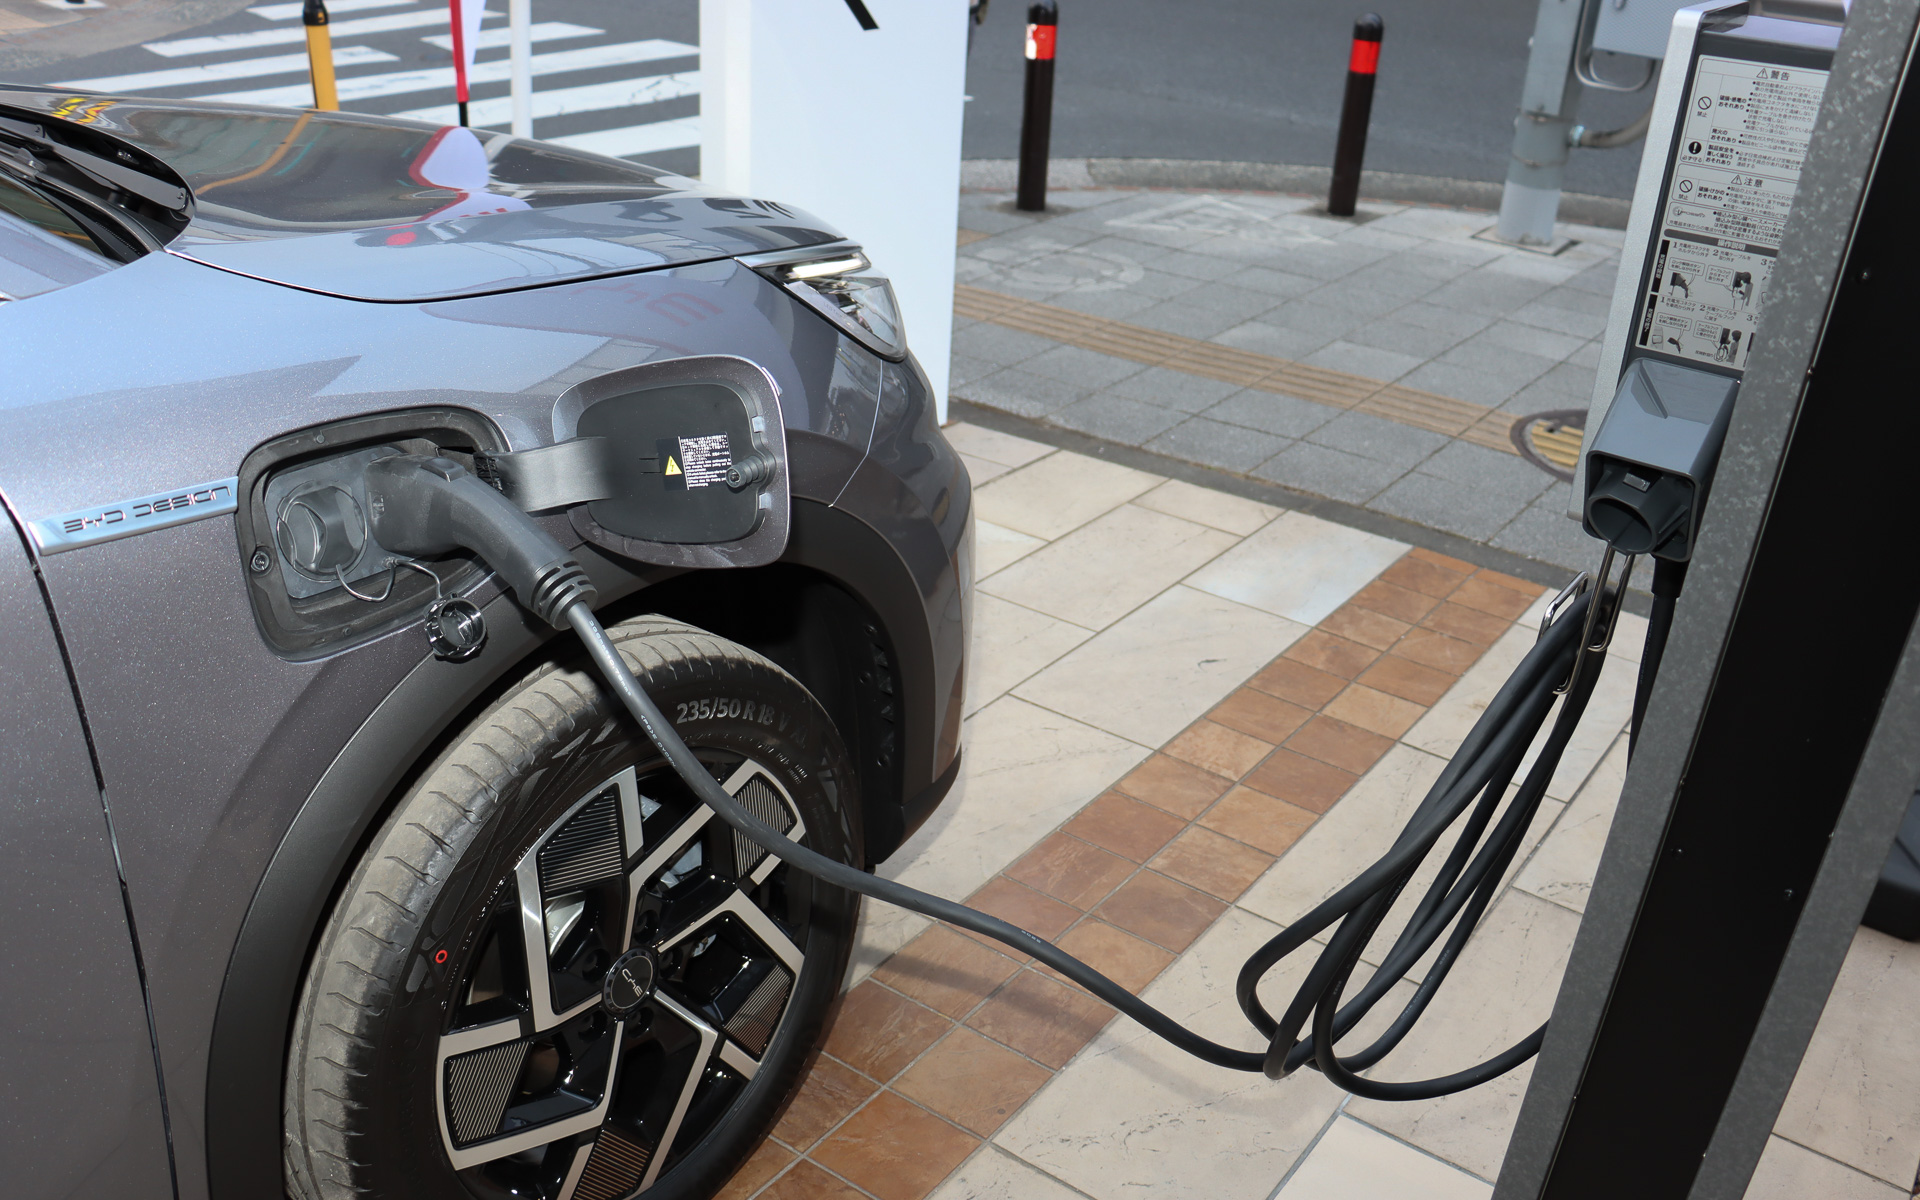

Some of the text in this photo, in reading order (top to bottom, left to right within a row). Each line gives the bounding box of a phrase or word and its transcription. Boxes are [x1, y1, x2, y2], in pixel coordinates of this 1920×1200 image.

[1770, 70, 1790, 81] 警告
[1743, 176, 1763, 188] 注意
[1712, 249, 1719, 257] 2
[1761, 258, 1768, 266] 3
[63, 509, 127, 533] BYD
[676, 697, 741, 725] 235/50
[742, 699, 756, 721] R
[757, 704, 776, 726] 18
